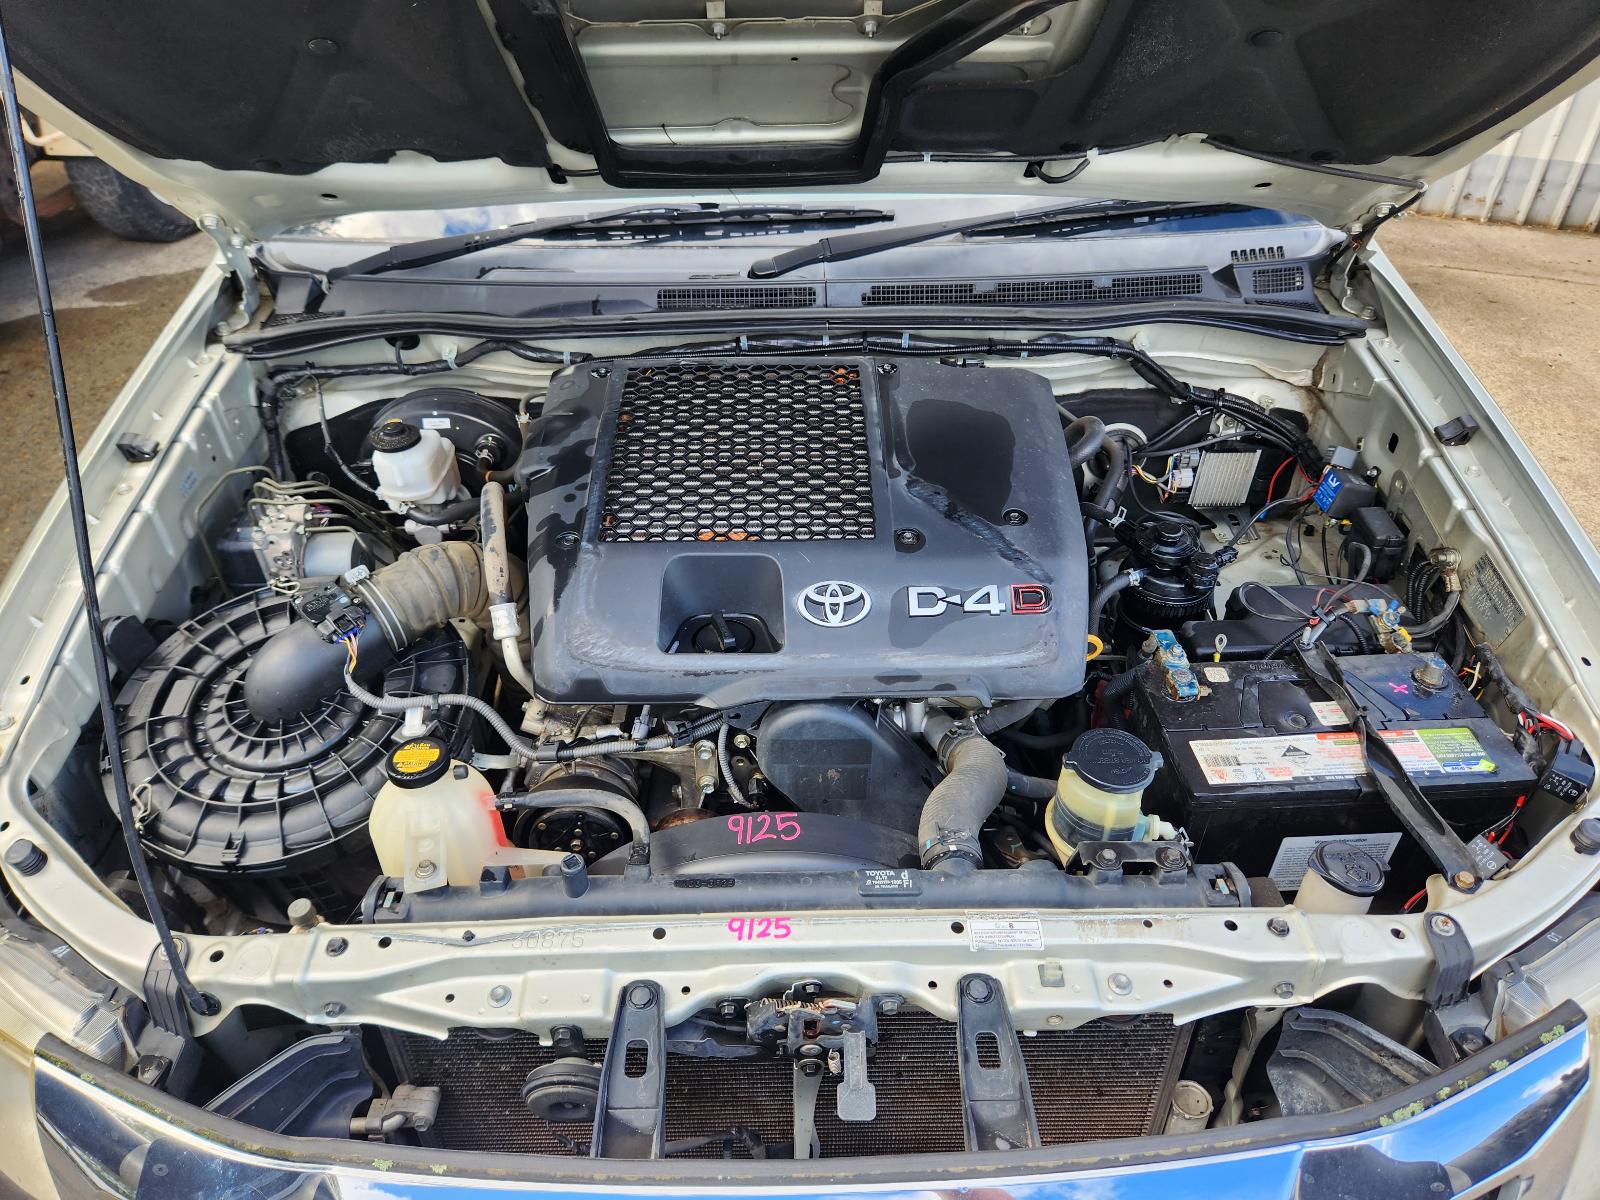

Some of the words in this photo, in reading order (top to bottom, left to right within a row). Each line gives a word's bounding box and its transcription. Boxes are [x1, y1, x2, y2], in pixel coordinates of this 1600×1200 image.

[908, 584, 1053, 617] D-4D
[727, 812, 801, 845] 9125
[727, 916, 792, 941] 9125
